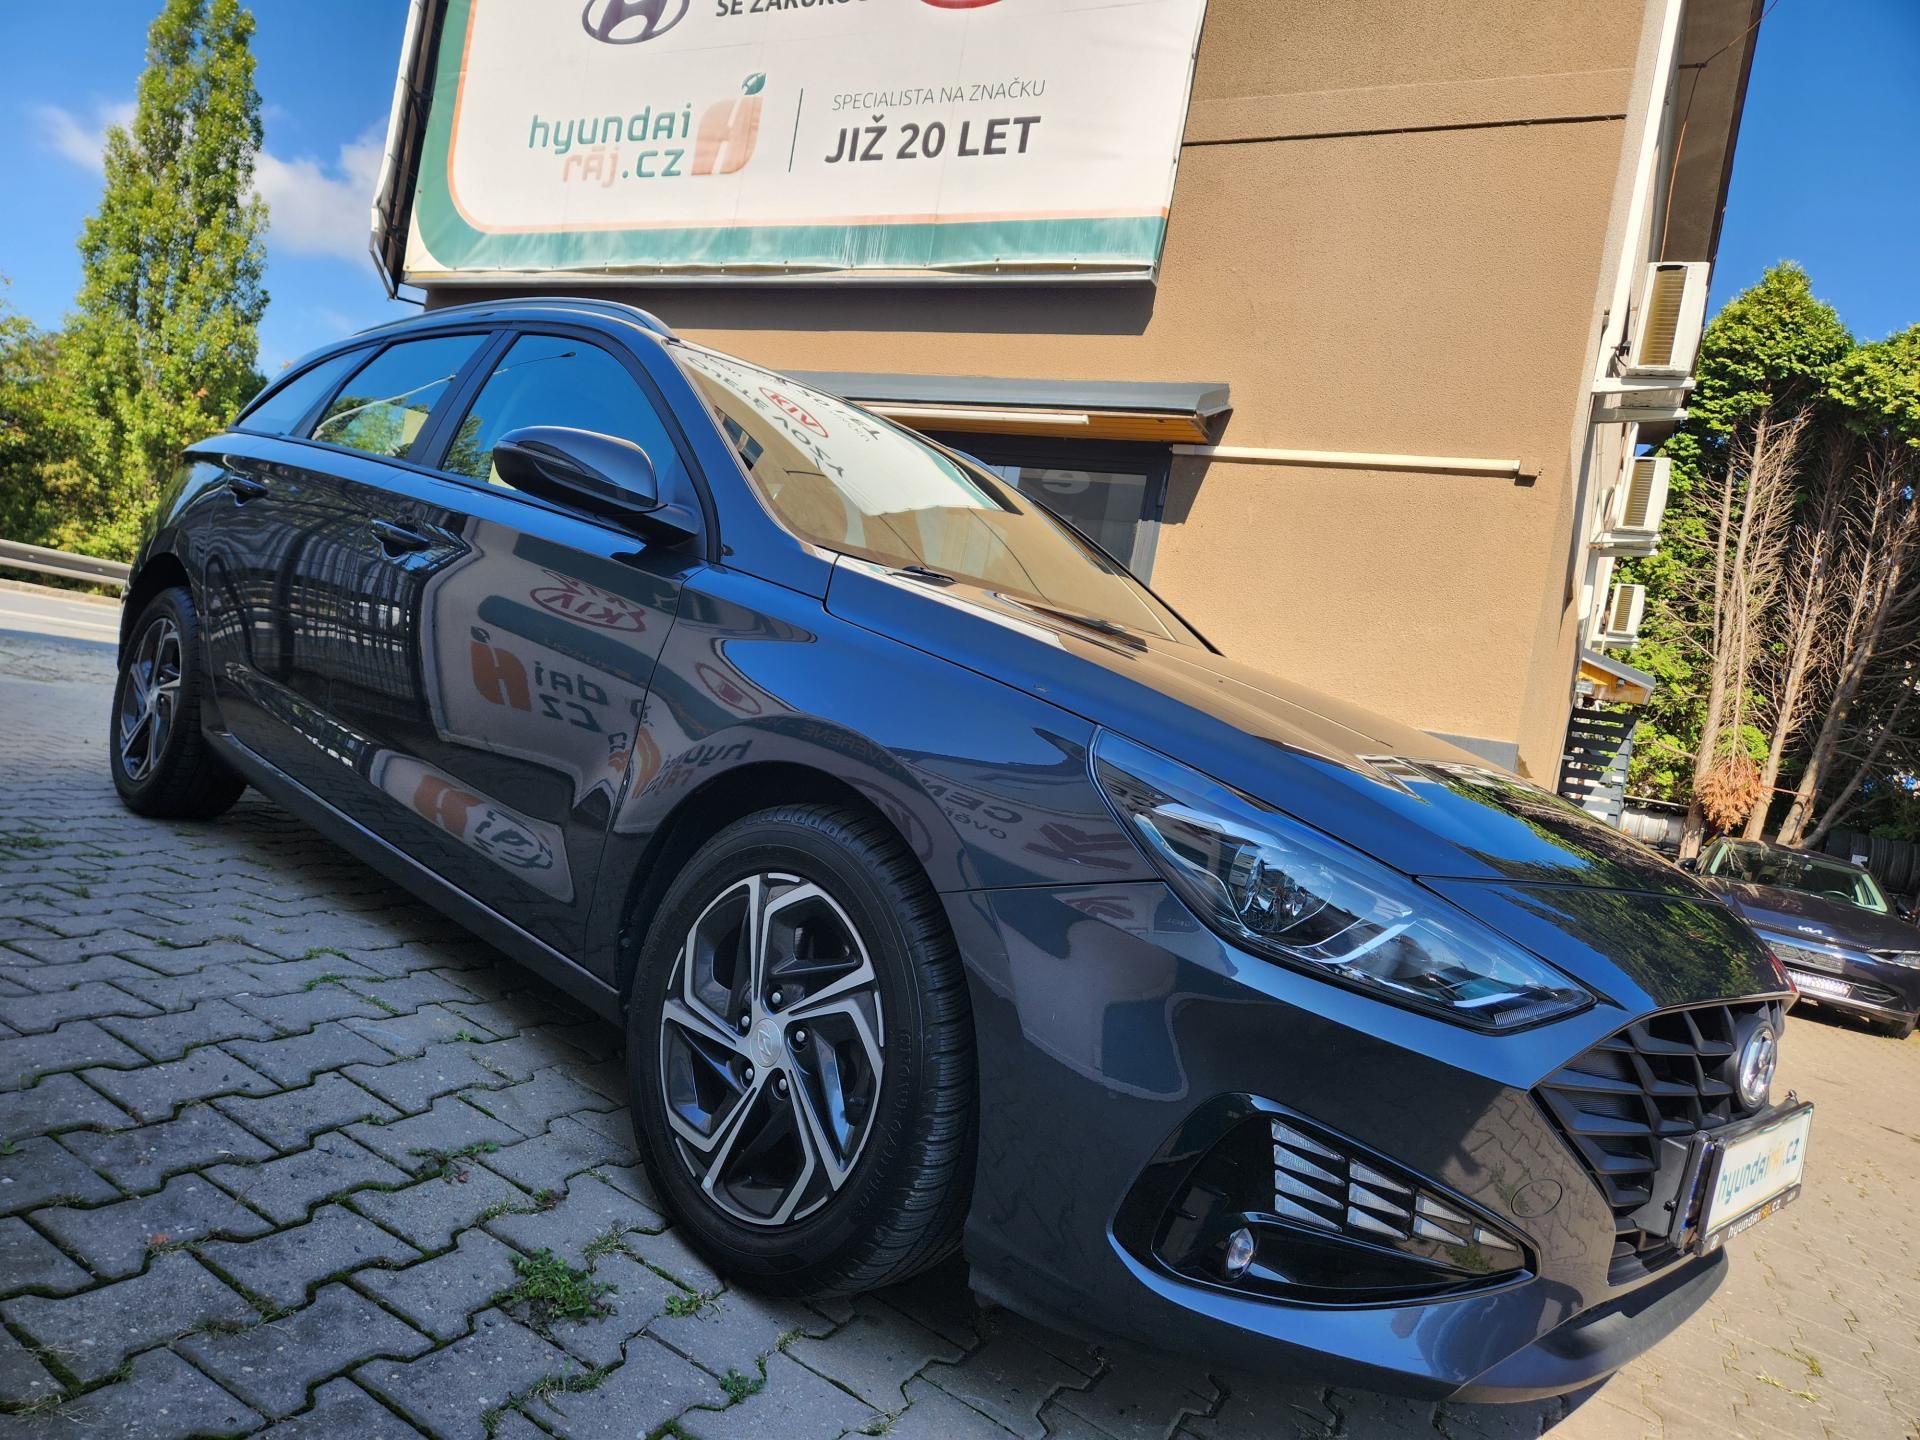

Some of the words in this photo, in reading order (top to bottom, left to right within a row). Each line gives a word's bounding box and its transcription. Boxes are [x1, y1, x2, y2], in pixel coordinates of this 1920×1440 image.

[716, 0, 743, 17] SE
[831, 88, 934, 111] SPECIALISTA
[940, 85, 964, 104] NA
[969, 76, 1046, 102] ZNAČKU
[528, 102, 693, 155] hyundai
[824, 114, 888, 163] JIŽ
[896, 121, 946, 160] 20
[957, 115, 1042, 157] LET
